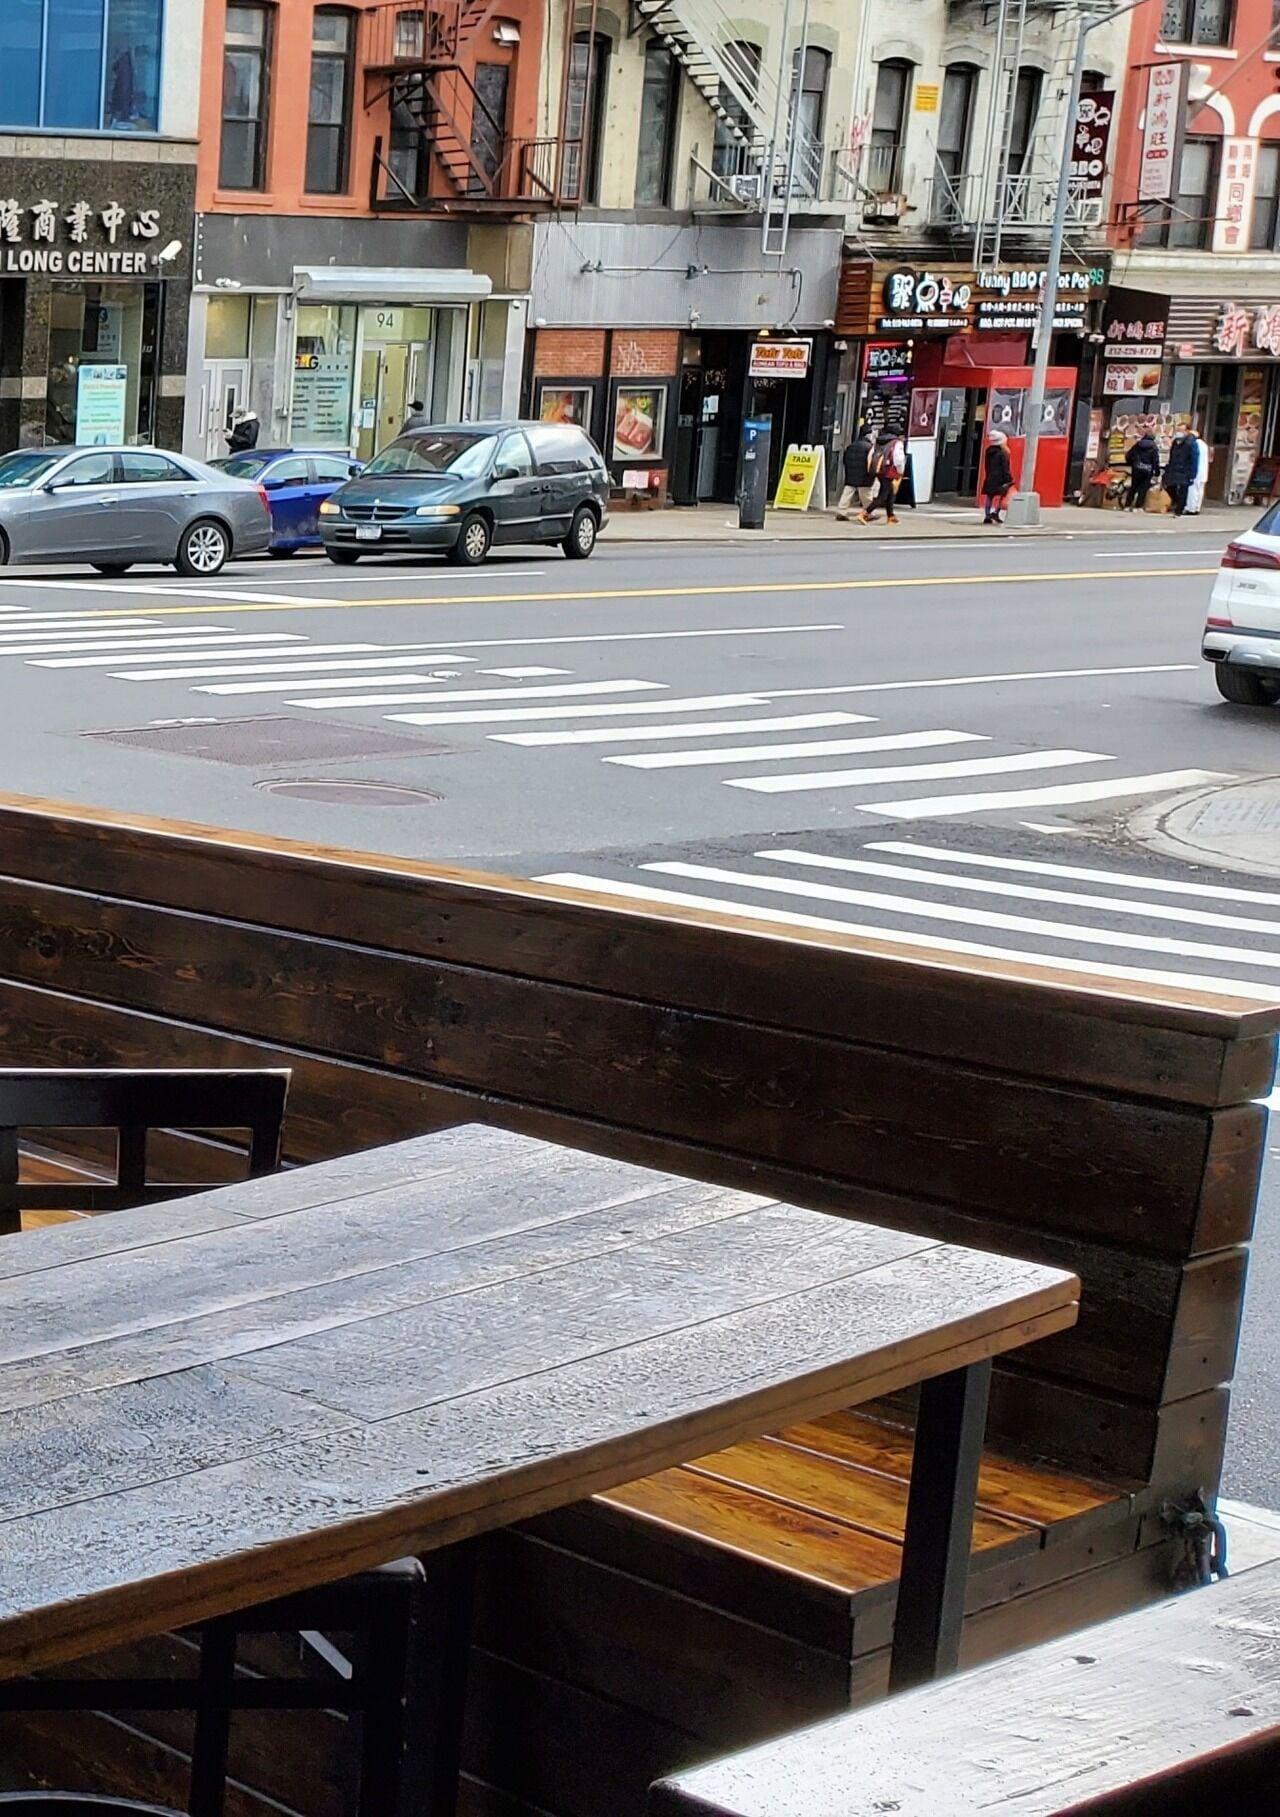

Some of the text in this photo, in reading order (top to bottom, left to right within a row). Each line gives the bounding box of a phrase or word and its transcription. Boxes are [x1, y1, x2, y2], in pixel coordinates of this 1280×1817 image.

[7, 250, 62, 272] LONG
[68, 252, 146, 273] CENTER
[1012, 271, 1036, 290] BBQ
[1056, 272, 1069, 289] ot
[377, 313, 393, 328] 94
[750, 430, 756, 440] P
[792, 456, 811, 464] TADA
